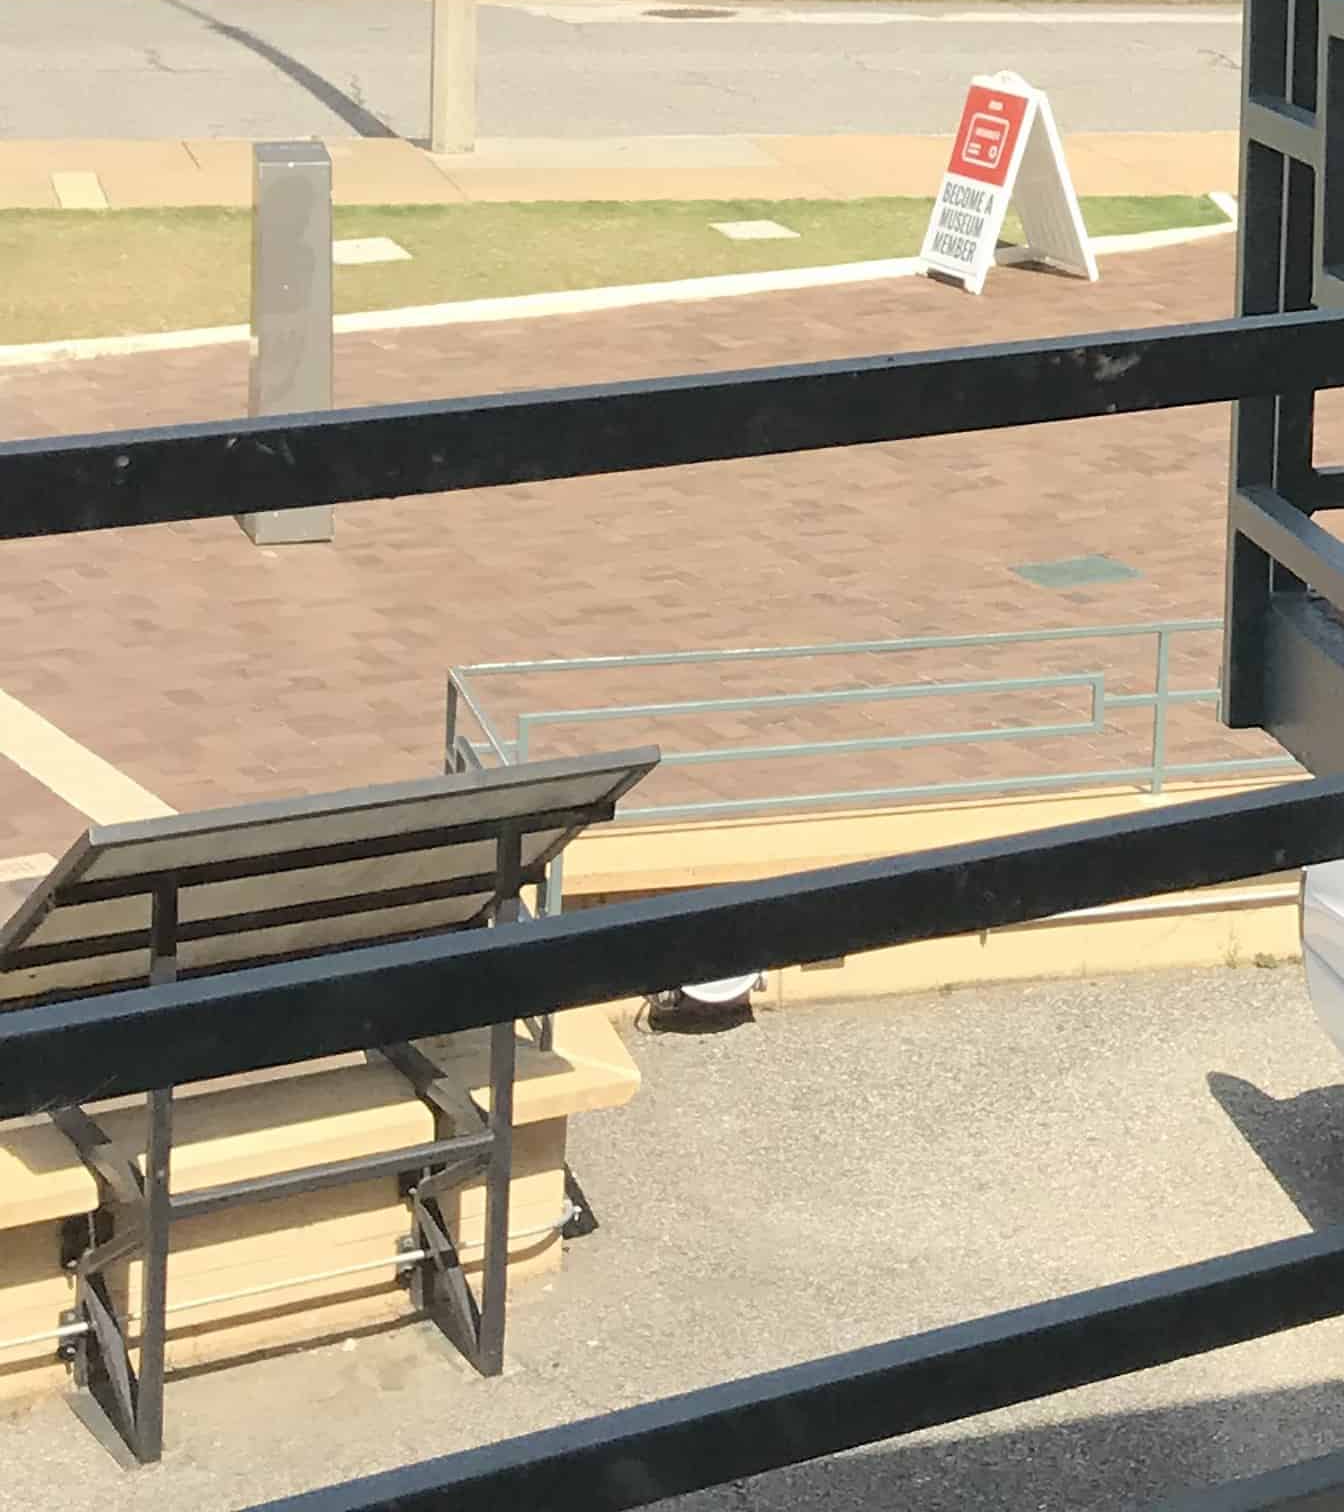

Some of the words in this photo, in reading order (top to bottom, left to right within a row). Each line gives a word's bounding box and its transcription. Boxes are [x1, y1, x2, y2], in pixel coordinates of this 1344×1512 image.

[941, 181, 986, 212] BECOME
[984, 193, 994, 216] A
[938, 207, 985, 238] MUSEUM
[931, 231, 977, 264] MEMBER
